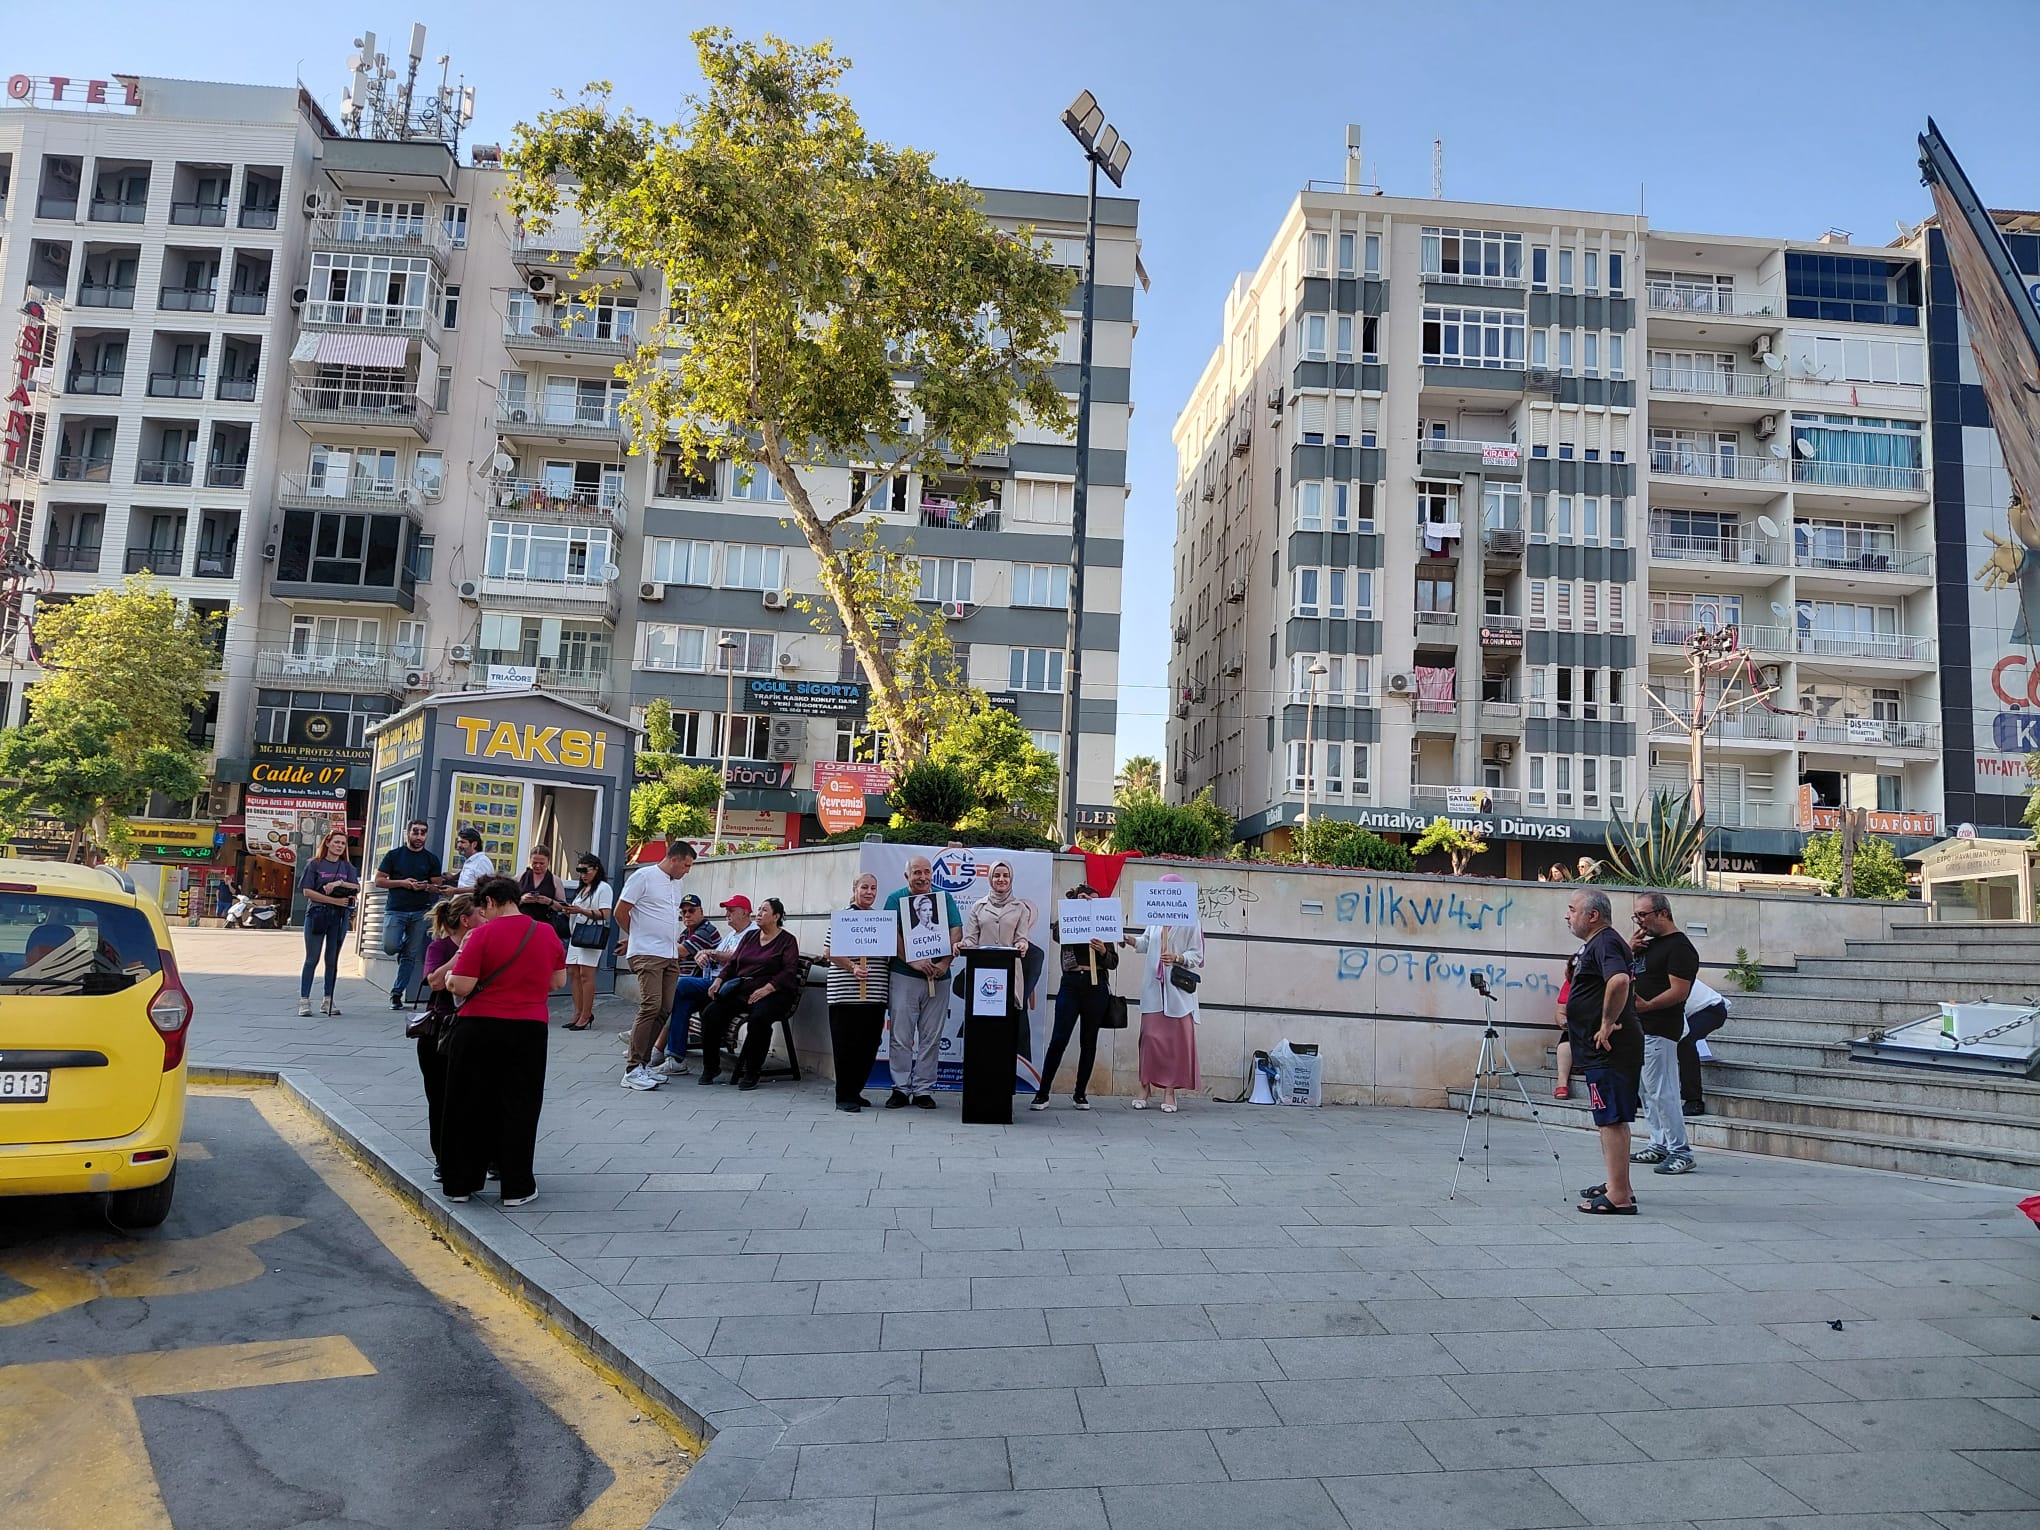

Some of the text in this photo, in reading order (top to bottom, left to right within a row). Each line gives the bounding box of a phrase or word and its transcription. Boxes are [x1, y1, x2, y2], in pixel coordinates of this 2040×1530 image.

[8, 74, 142, 107] OTEL
[4, 326, 42, 462] START
[751, 679, 860, 697] OĞUL SİGORTA
[275, 745, 297, 754] HAIR
[300, 747, 334, 757] PROTEZ
[335, 749, 371, 759] SALOON
[252, 763, 345, 784] Cadde 07
[295, 800, 345, 810] KAMPANYA
[820, 795, 863, 810] Çevremizi
[1358, 811, 1425, 832] Antalya
[1501, 816, 1571, 839] Dünyası
[1868, 816, 1933, 832] UAFÖRÜ
[1706, 857, 1757, 871] YRUM
[1149, 888, 1182, 896] SEKTÖRÜ
[1146, 899, 1187, 908] KARANLIĞA
[1147, 911, 1189, 920] GÖMMEYİN
[850, 926, 877, 934] GEÇMİŞ
[1062, 926, 1092, 935] GELİŞİME
[912, 933, 942, 945] GEÇMİŞ
[915, 948, 941, 958] OLSUN
